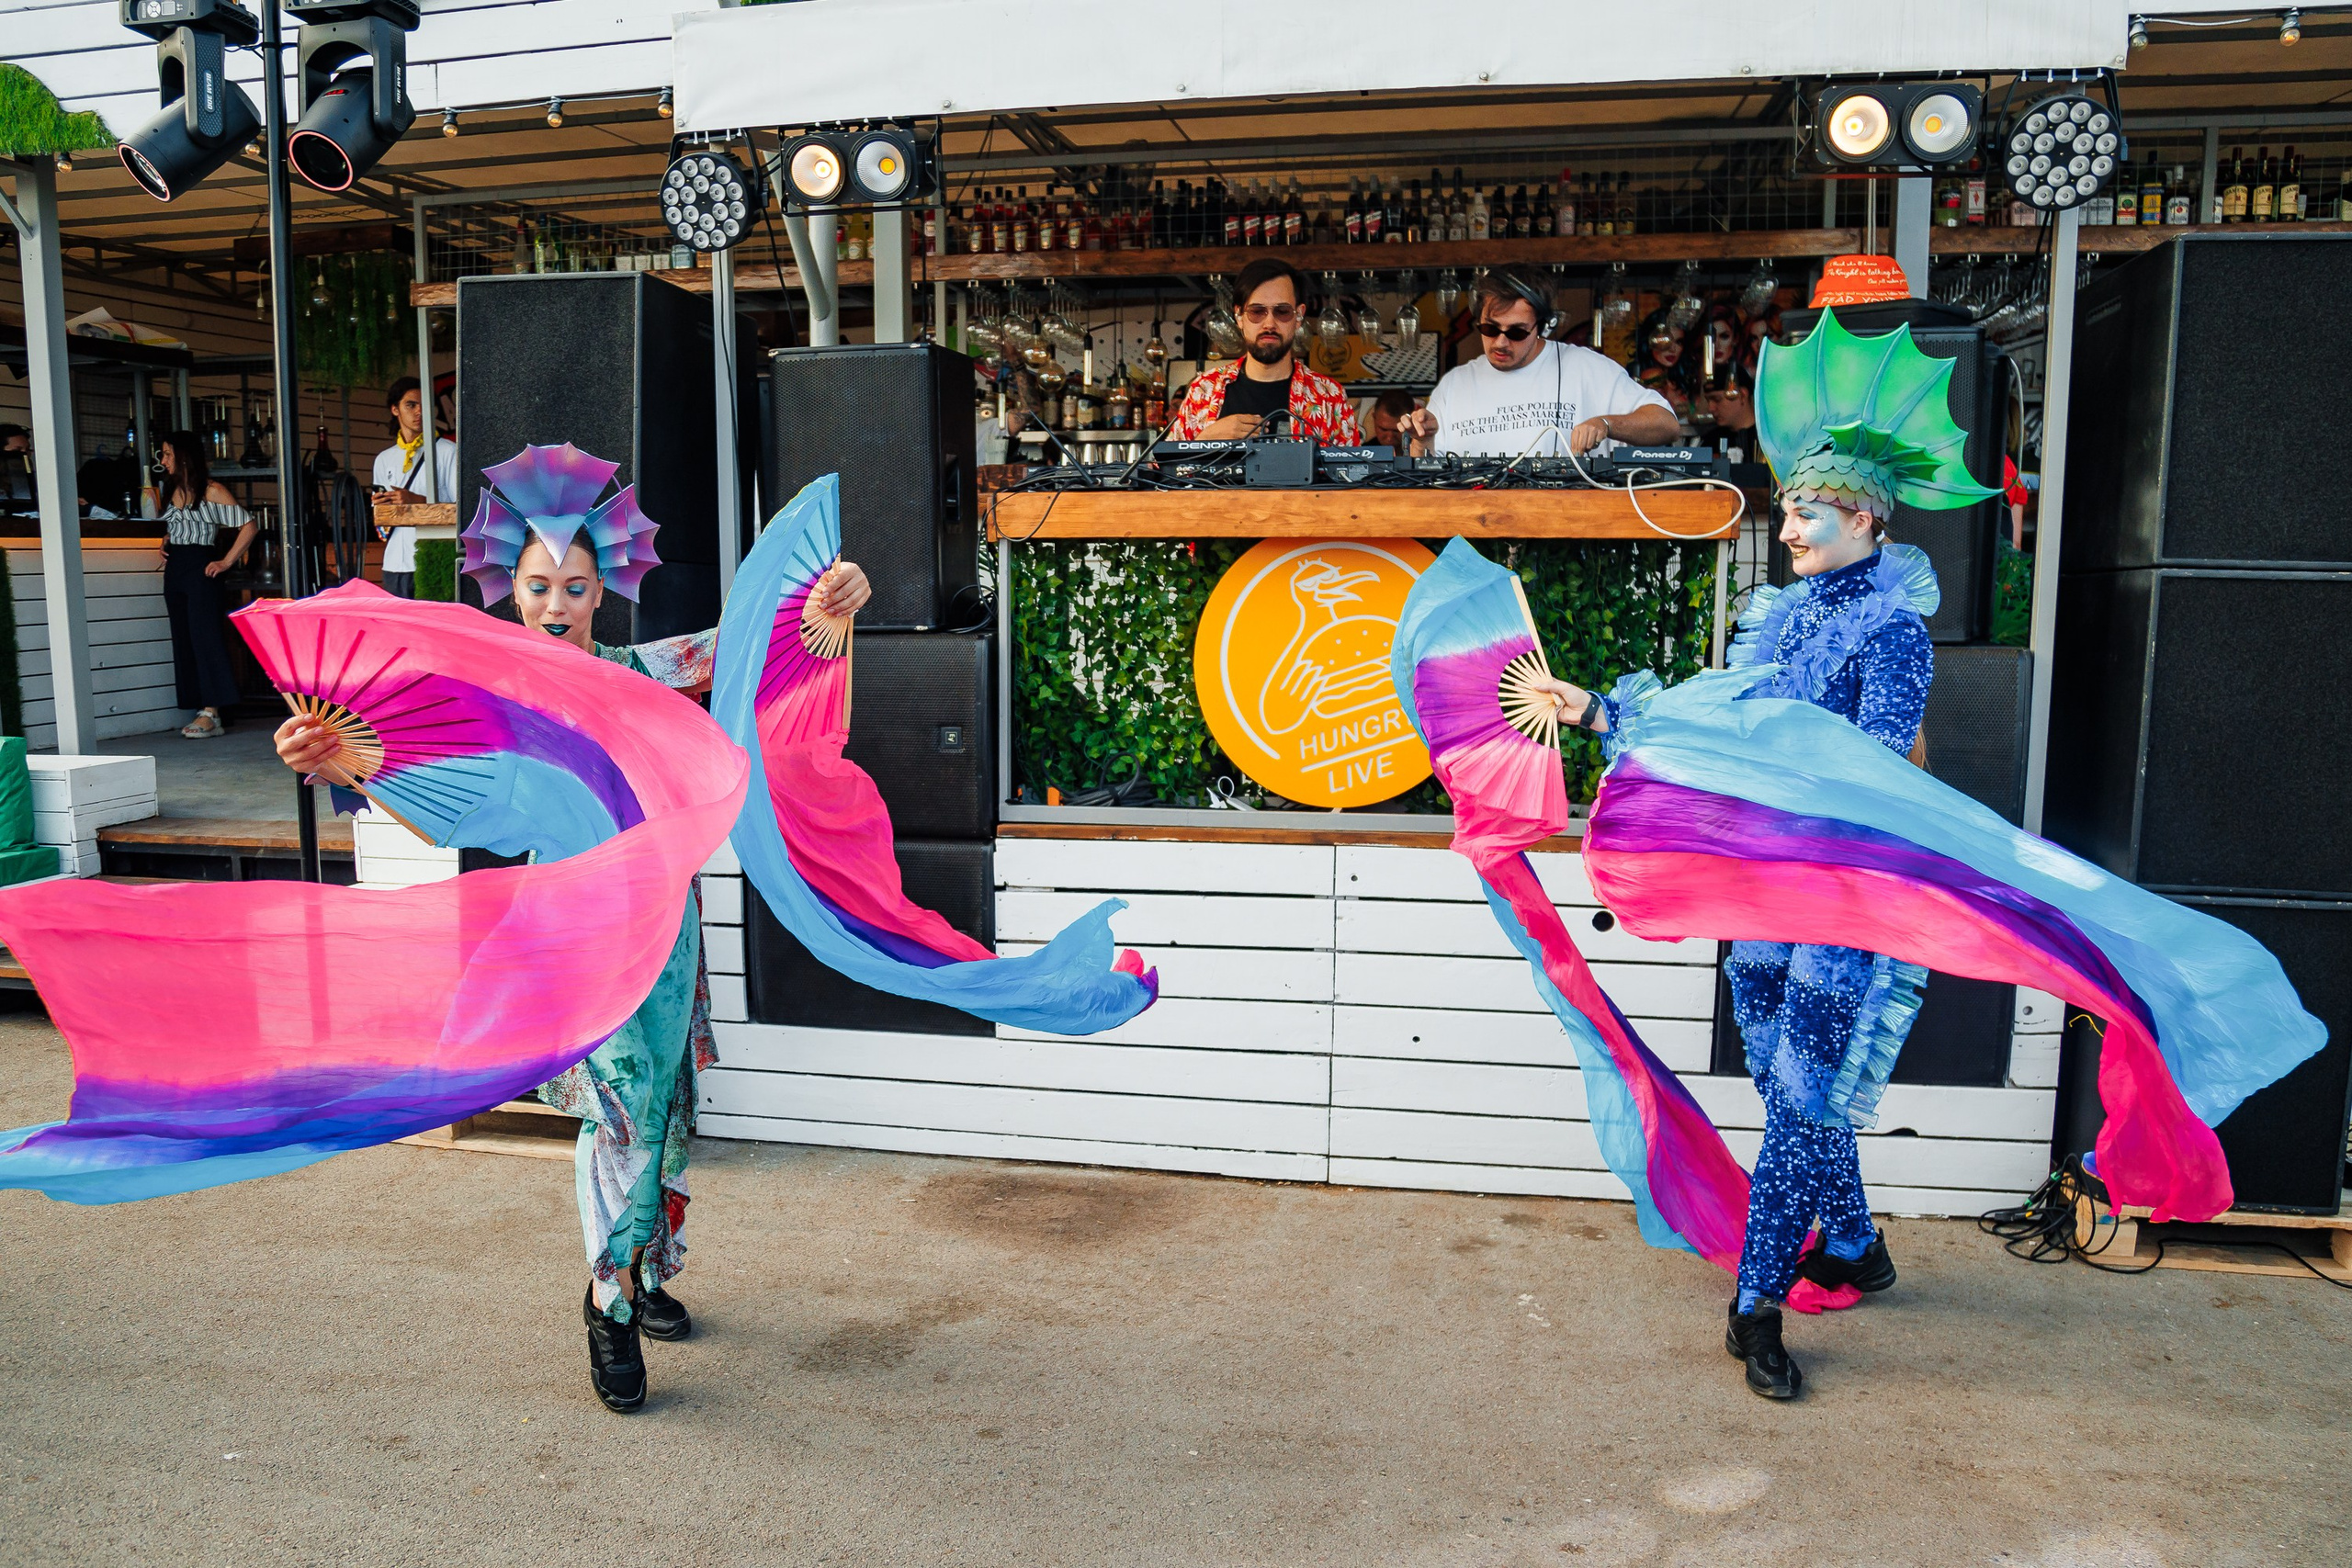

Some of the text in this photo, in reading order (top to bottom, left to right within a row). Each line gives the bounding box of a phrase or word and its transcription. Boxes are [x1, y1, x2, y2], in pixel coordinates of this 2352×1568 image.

[1497, 402, 1577, 415] FUCK POLITICS
[1452, 411, 1577, 431] FUCK THE MASS MARKET
[1460, 419, 1575, 437] FUCK THE ILLUMINATI
[1178, 442, 1233, 450] DENON
[1632, 449, 1679, 459] Pioneer
[1328, 751, 1395, 794] LIVE
